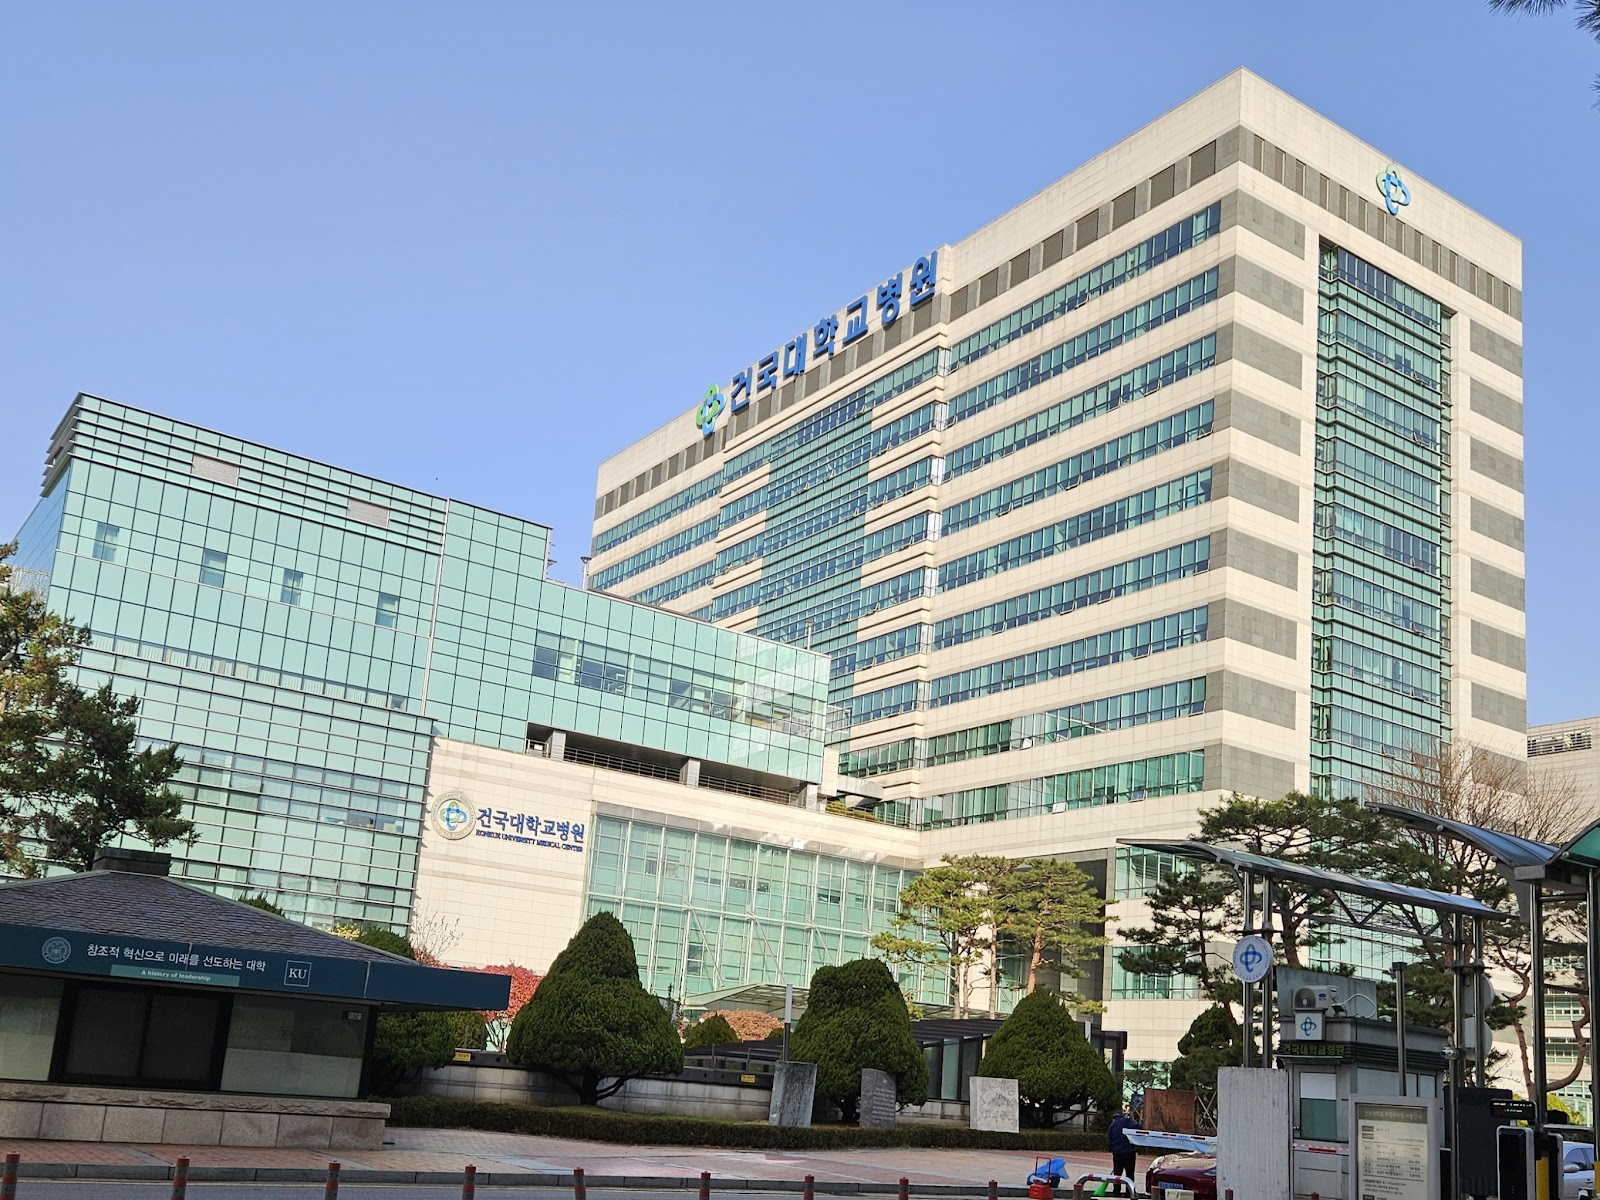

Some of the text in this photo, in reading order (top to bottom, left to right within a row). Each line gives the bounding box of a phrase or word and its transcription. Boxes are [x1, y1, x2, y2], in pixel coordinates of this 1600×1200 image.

[730, 250, 938, 413] 건국대학교병원
[476, 807, 585, 844] 건국대학교병원
[475, 829, 501, 840] KONKUK
[501, 833, 536, 846] UNIVERSITY
[536, 839, 561, 850] MEDICAL
[561, 843, 583, 852] CENTER
[87, 943, 119, 958] 창조적
[123, 947, 165, 962] 혁신으로
[168, 952, 200, 966] 미래를
[203, 955, 243, 970] 선도하는
[245, 960, 266, 972] 대학
[147, 970, 170, 978] history
[178, 973, 211, 982] leadership
[288, 967, 308, 979] KU
